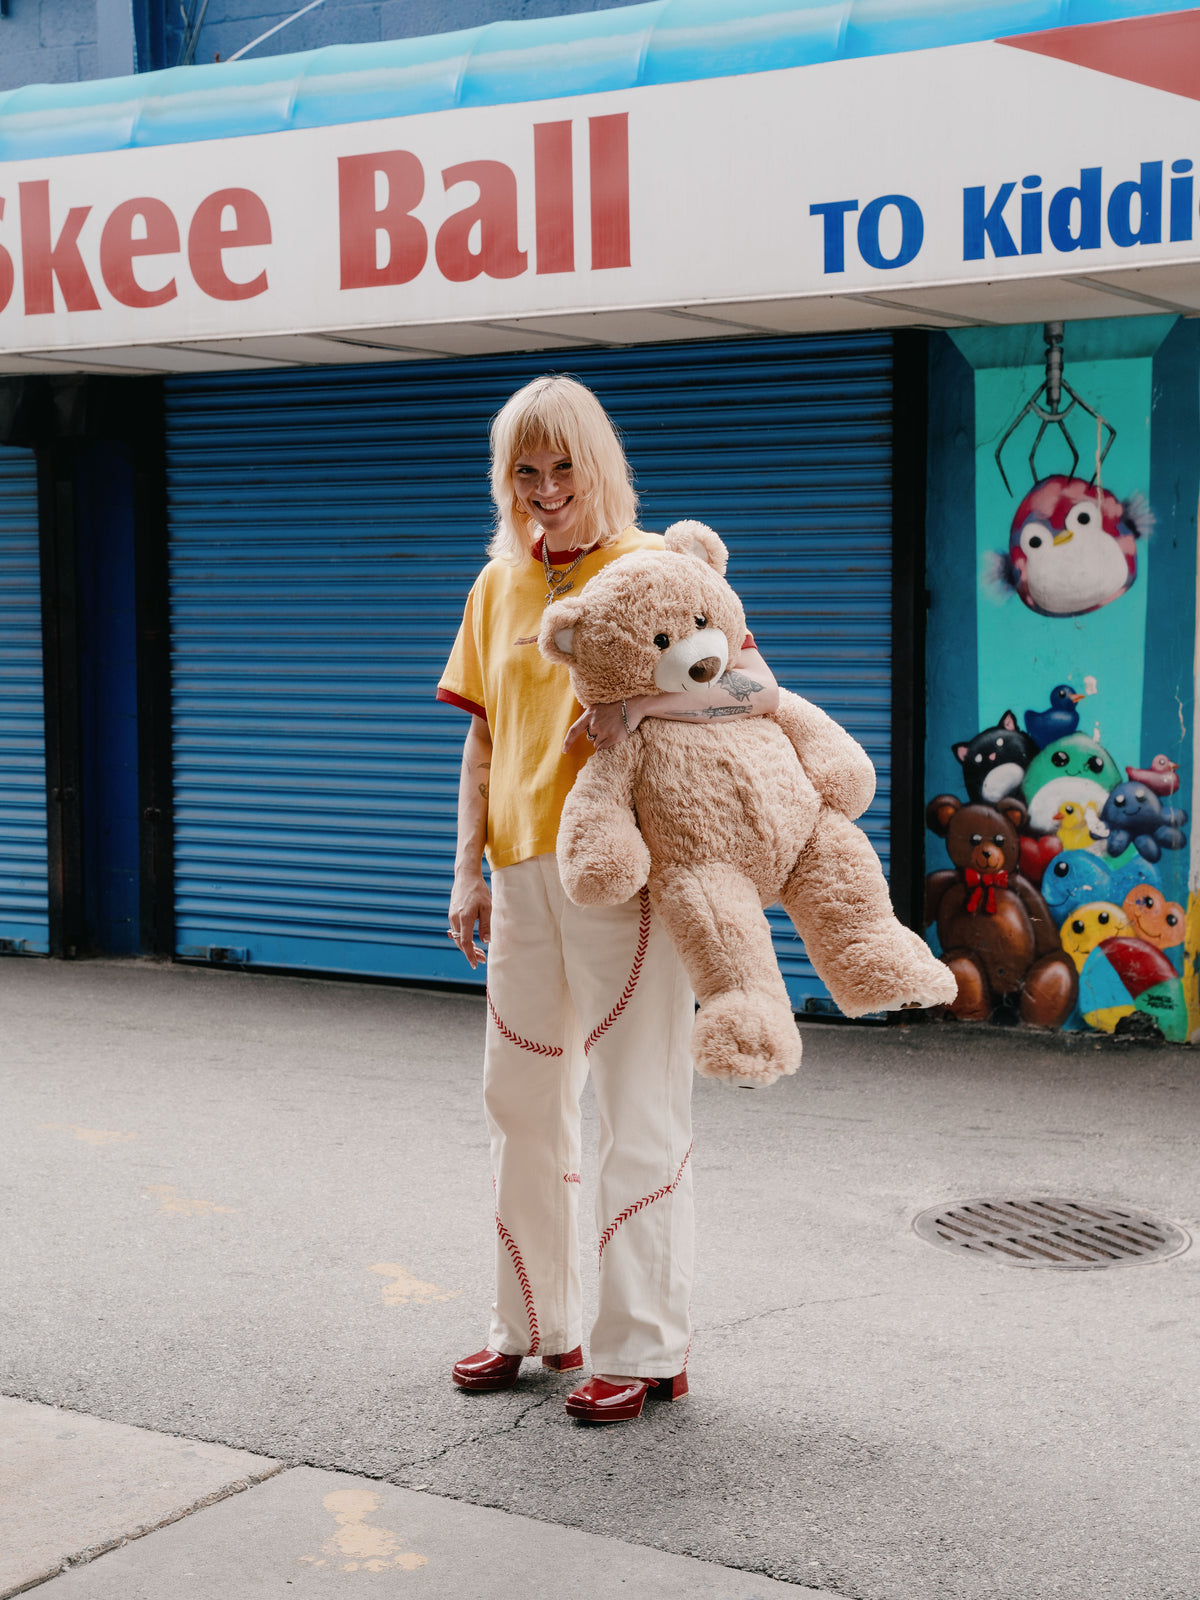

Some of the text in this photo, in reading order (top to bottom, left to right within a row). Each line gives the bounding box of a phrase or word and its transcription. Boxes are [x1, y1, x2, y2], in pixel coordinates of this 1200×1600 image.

[0, 112, 632, 317] kee Ball
[809, 158, 1200, 274] TO Kiddi
